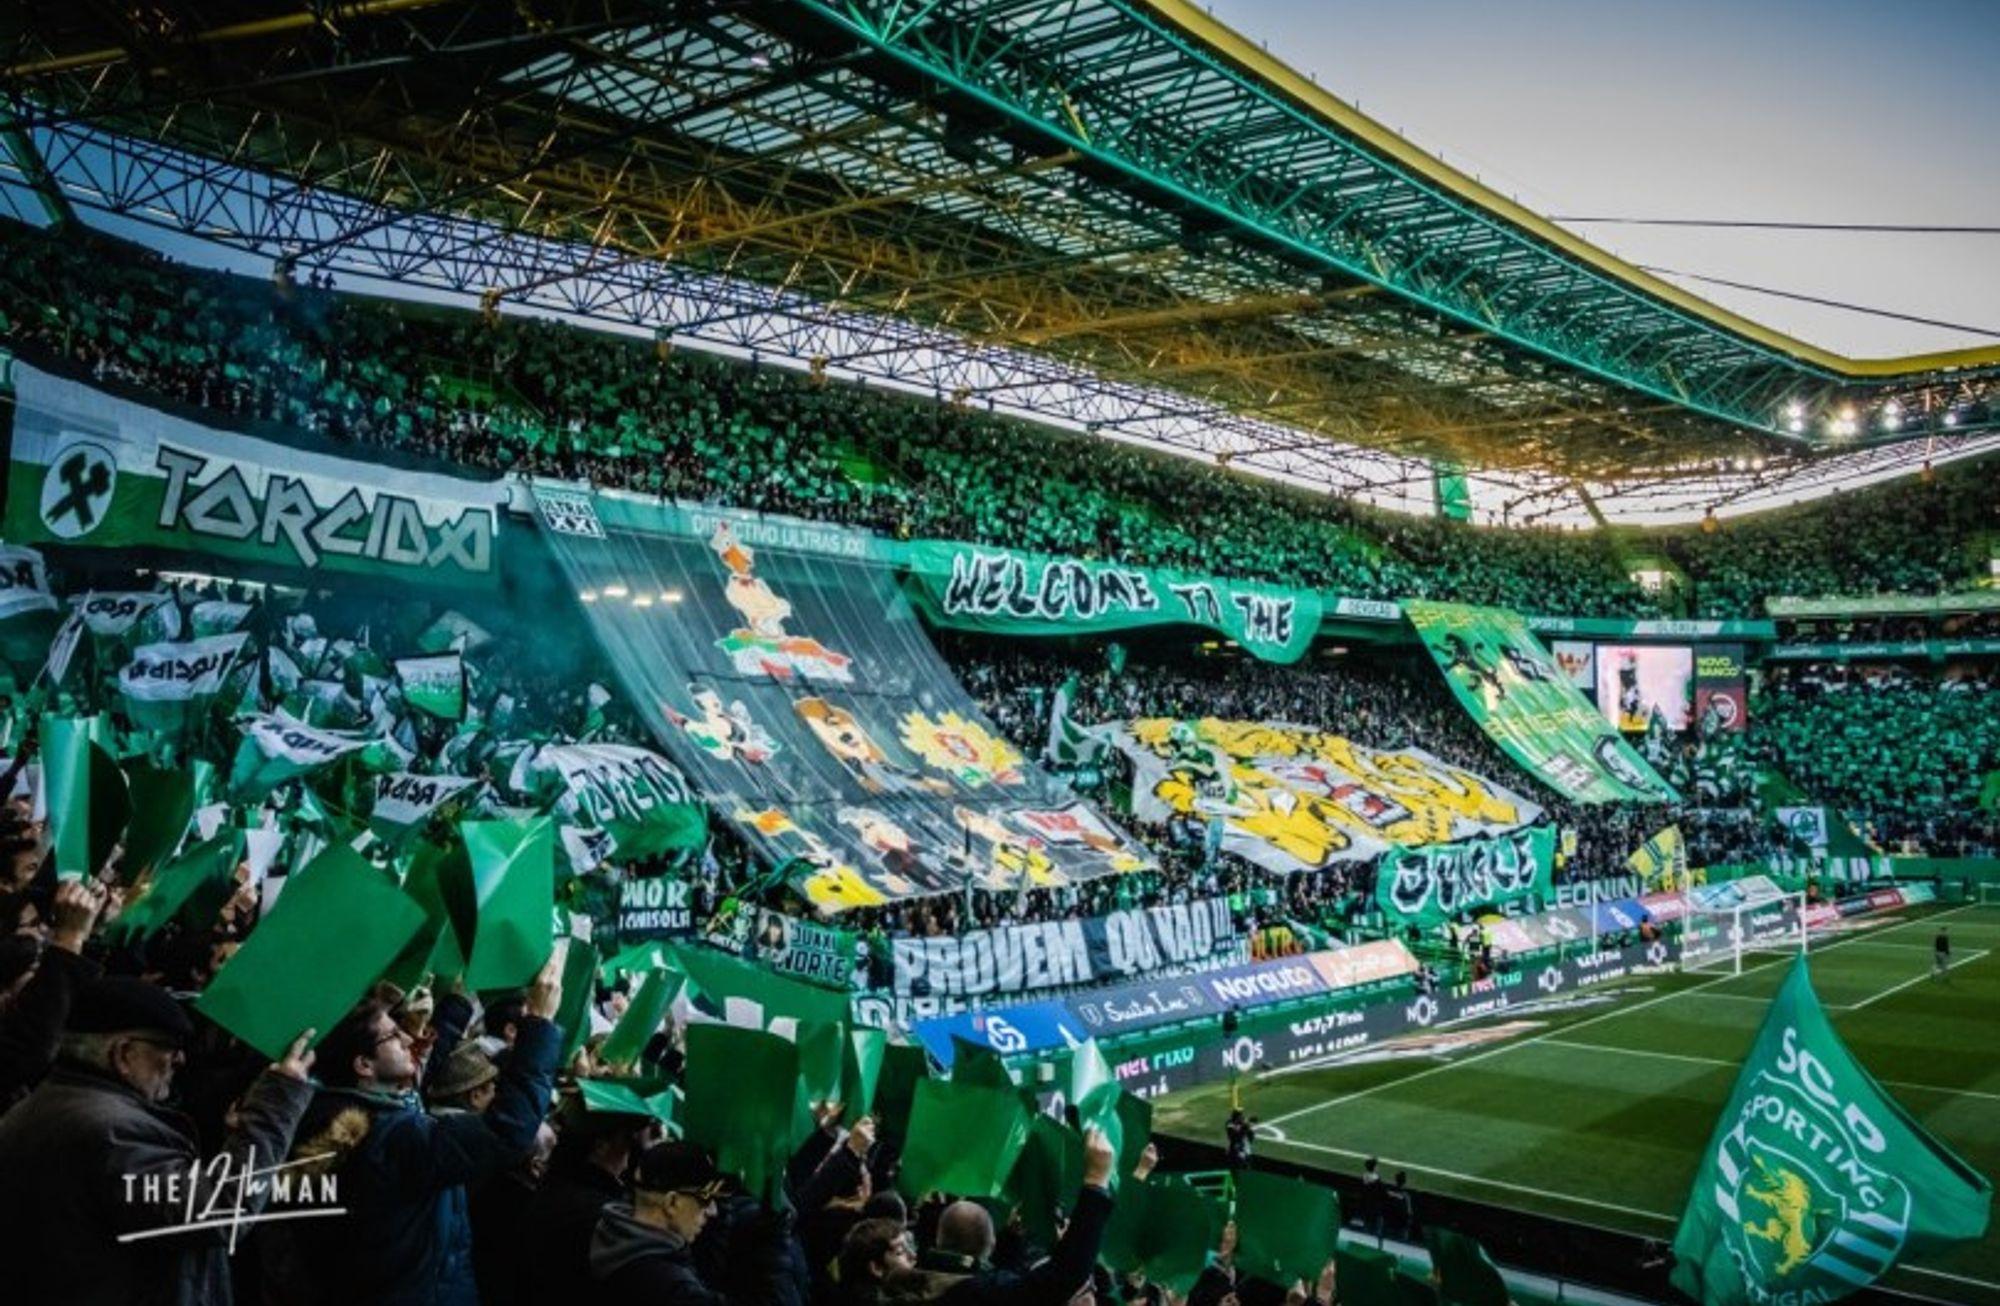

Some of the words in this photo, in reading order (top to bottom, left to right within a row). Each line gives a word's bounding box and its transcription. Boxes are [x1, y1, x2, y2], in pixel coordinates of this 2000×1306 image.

[155, 443, 493, 571] TORCIDA
[944, 552, 1159, 619] WELCOME
[1168, 581, 1223, 626] TO
[1230, 591, 1296, 648] THE
[892, 921, 1096, 998] PROVEM
[1211, 965, 1314, 1001] Norauto
[1222, 1036, 1265, 1072] NOS
